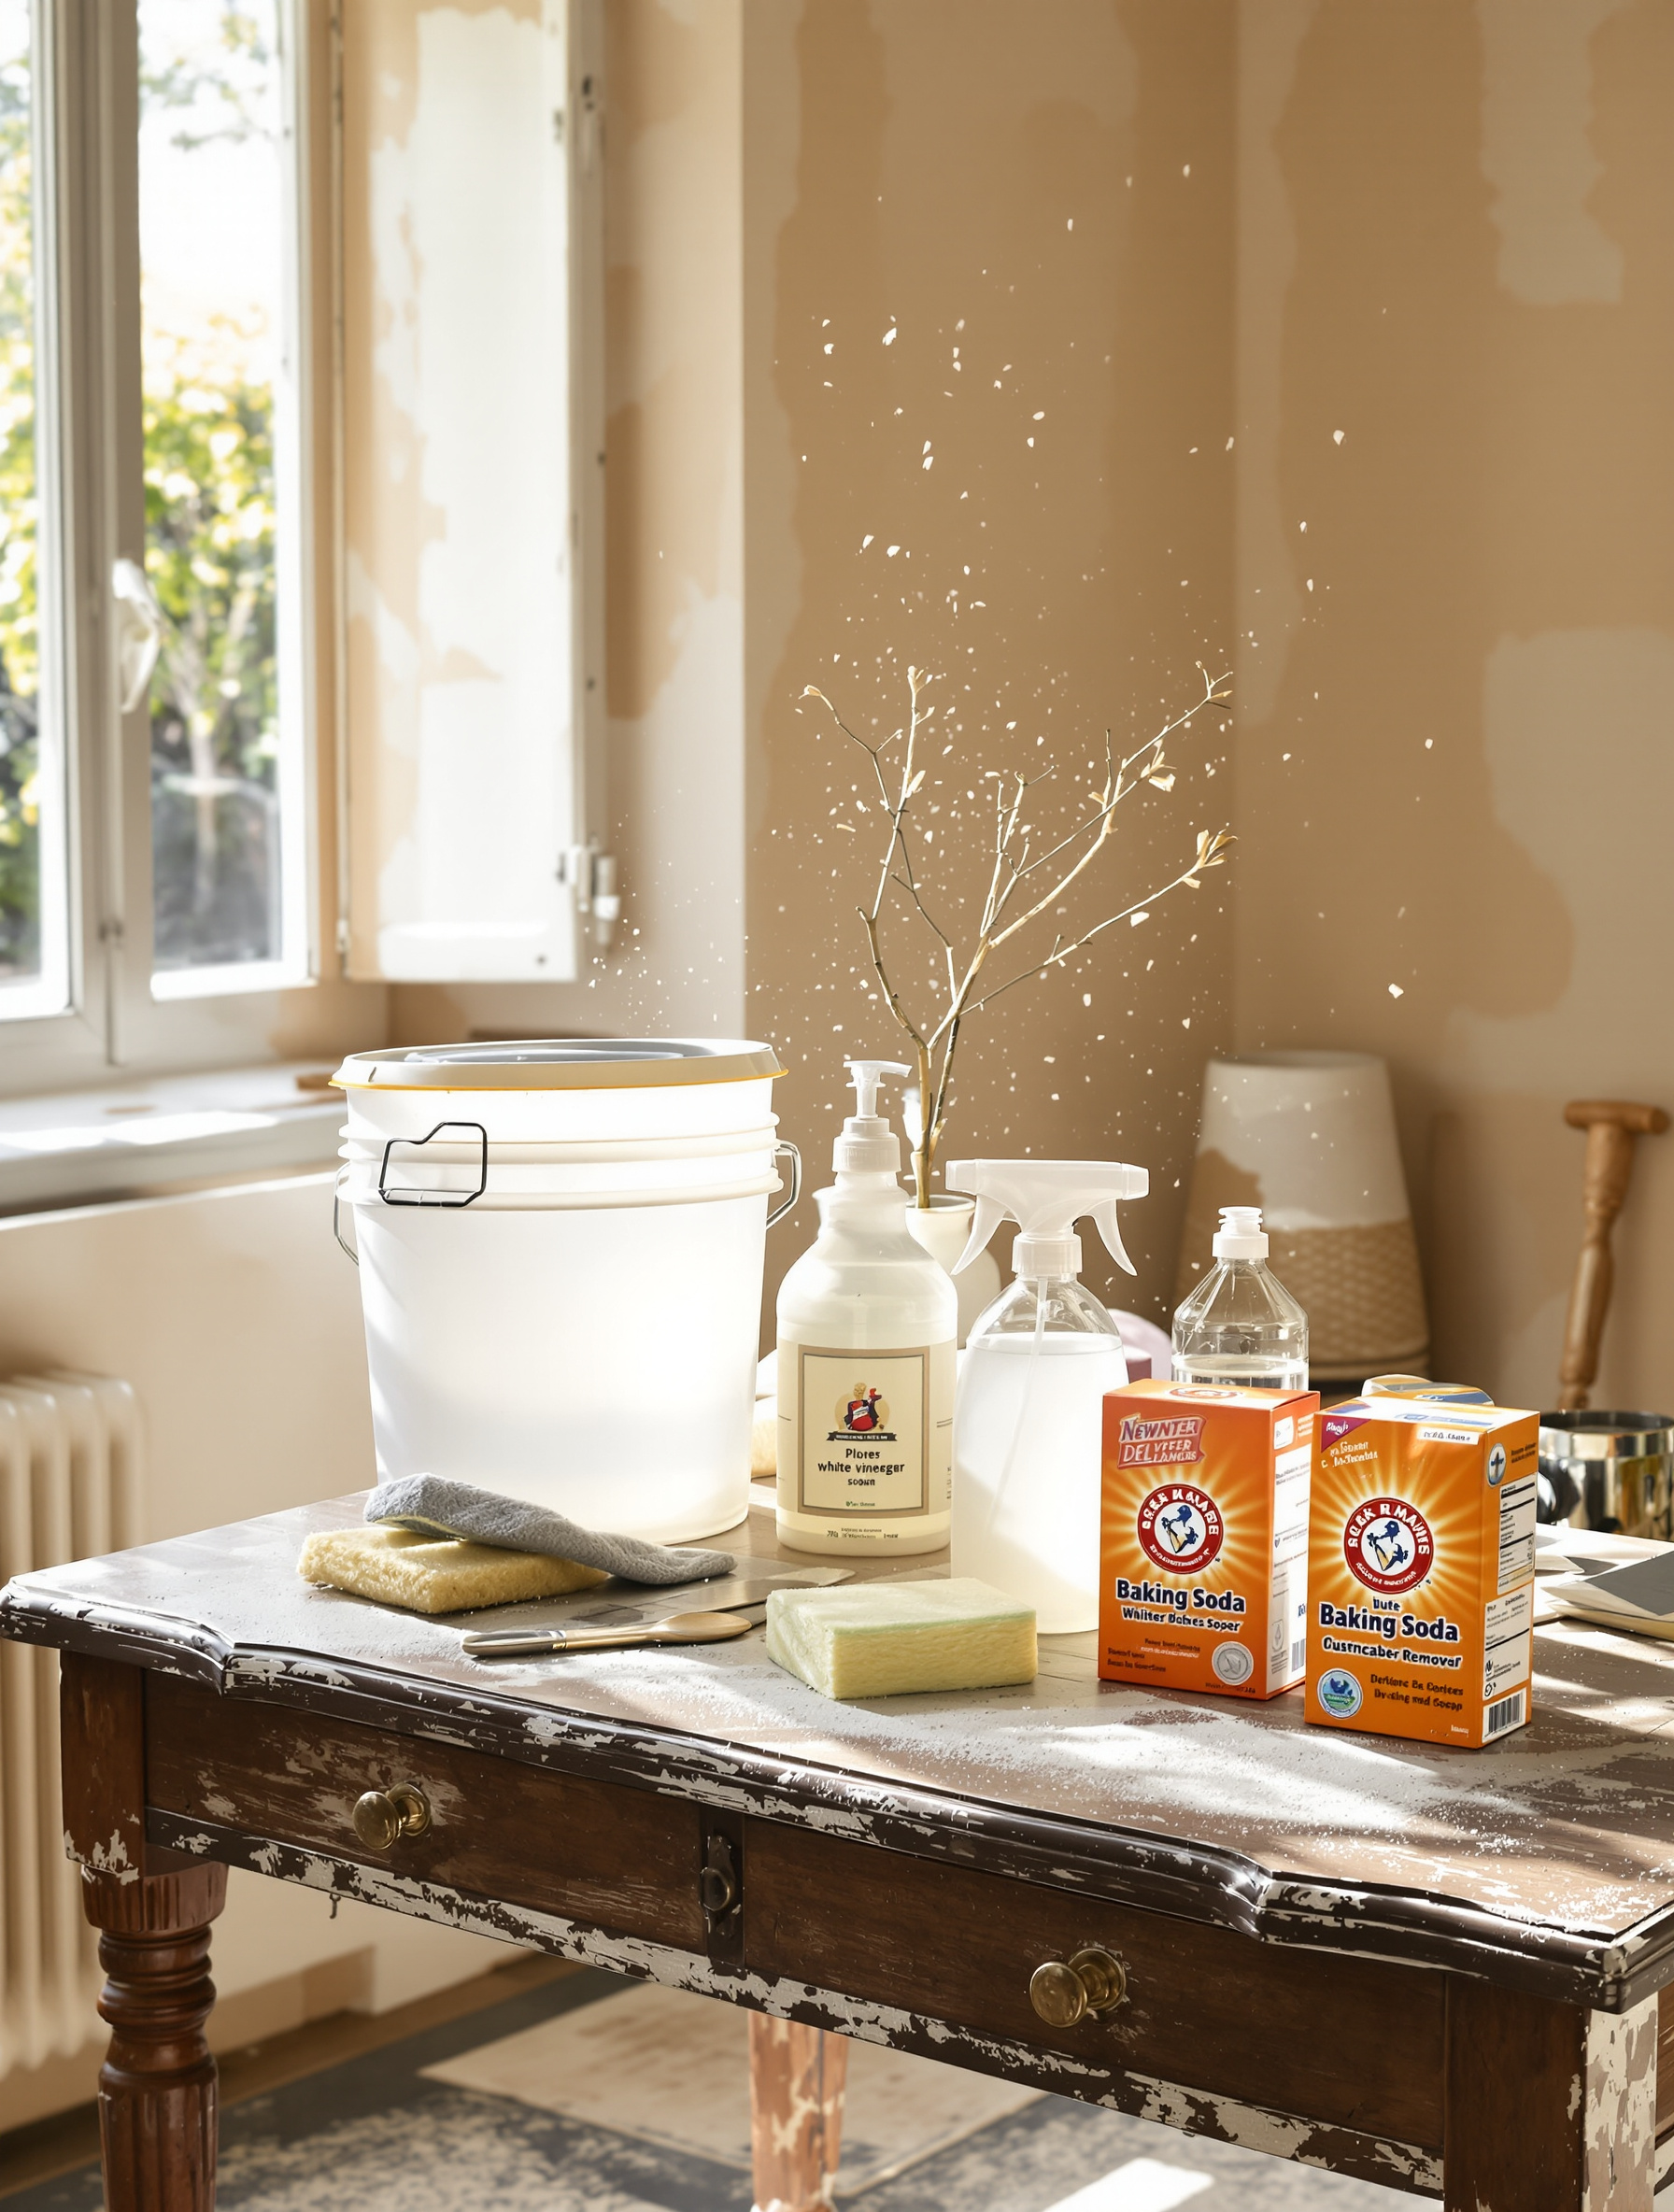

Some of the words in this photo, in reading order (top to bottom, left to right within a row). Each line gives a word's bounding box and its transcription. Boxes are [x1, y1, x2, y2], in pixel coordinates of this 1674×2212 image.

[1116, 1579, 1188, 1610] Baking
[1193, 1588, 1245, 1612] Soda
[1320, 1603, 1397, 1639] Baking
[1402, 1615, 1458, 1641] Soda
